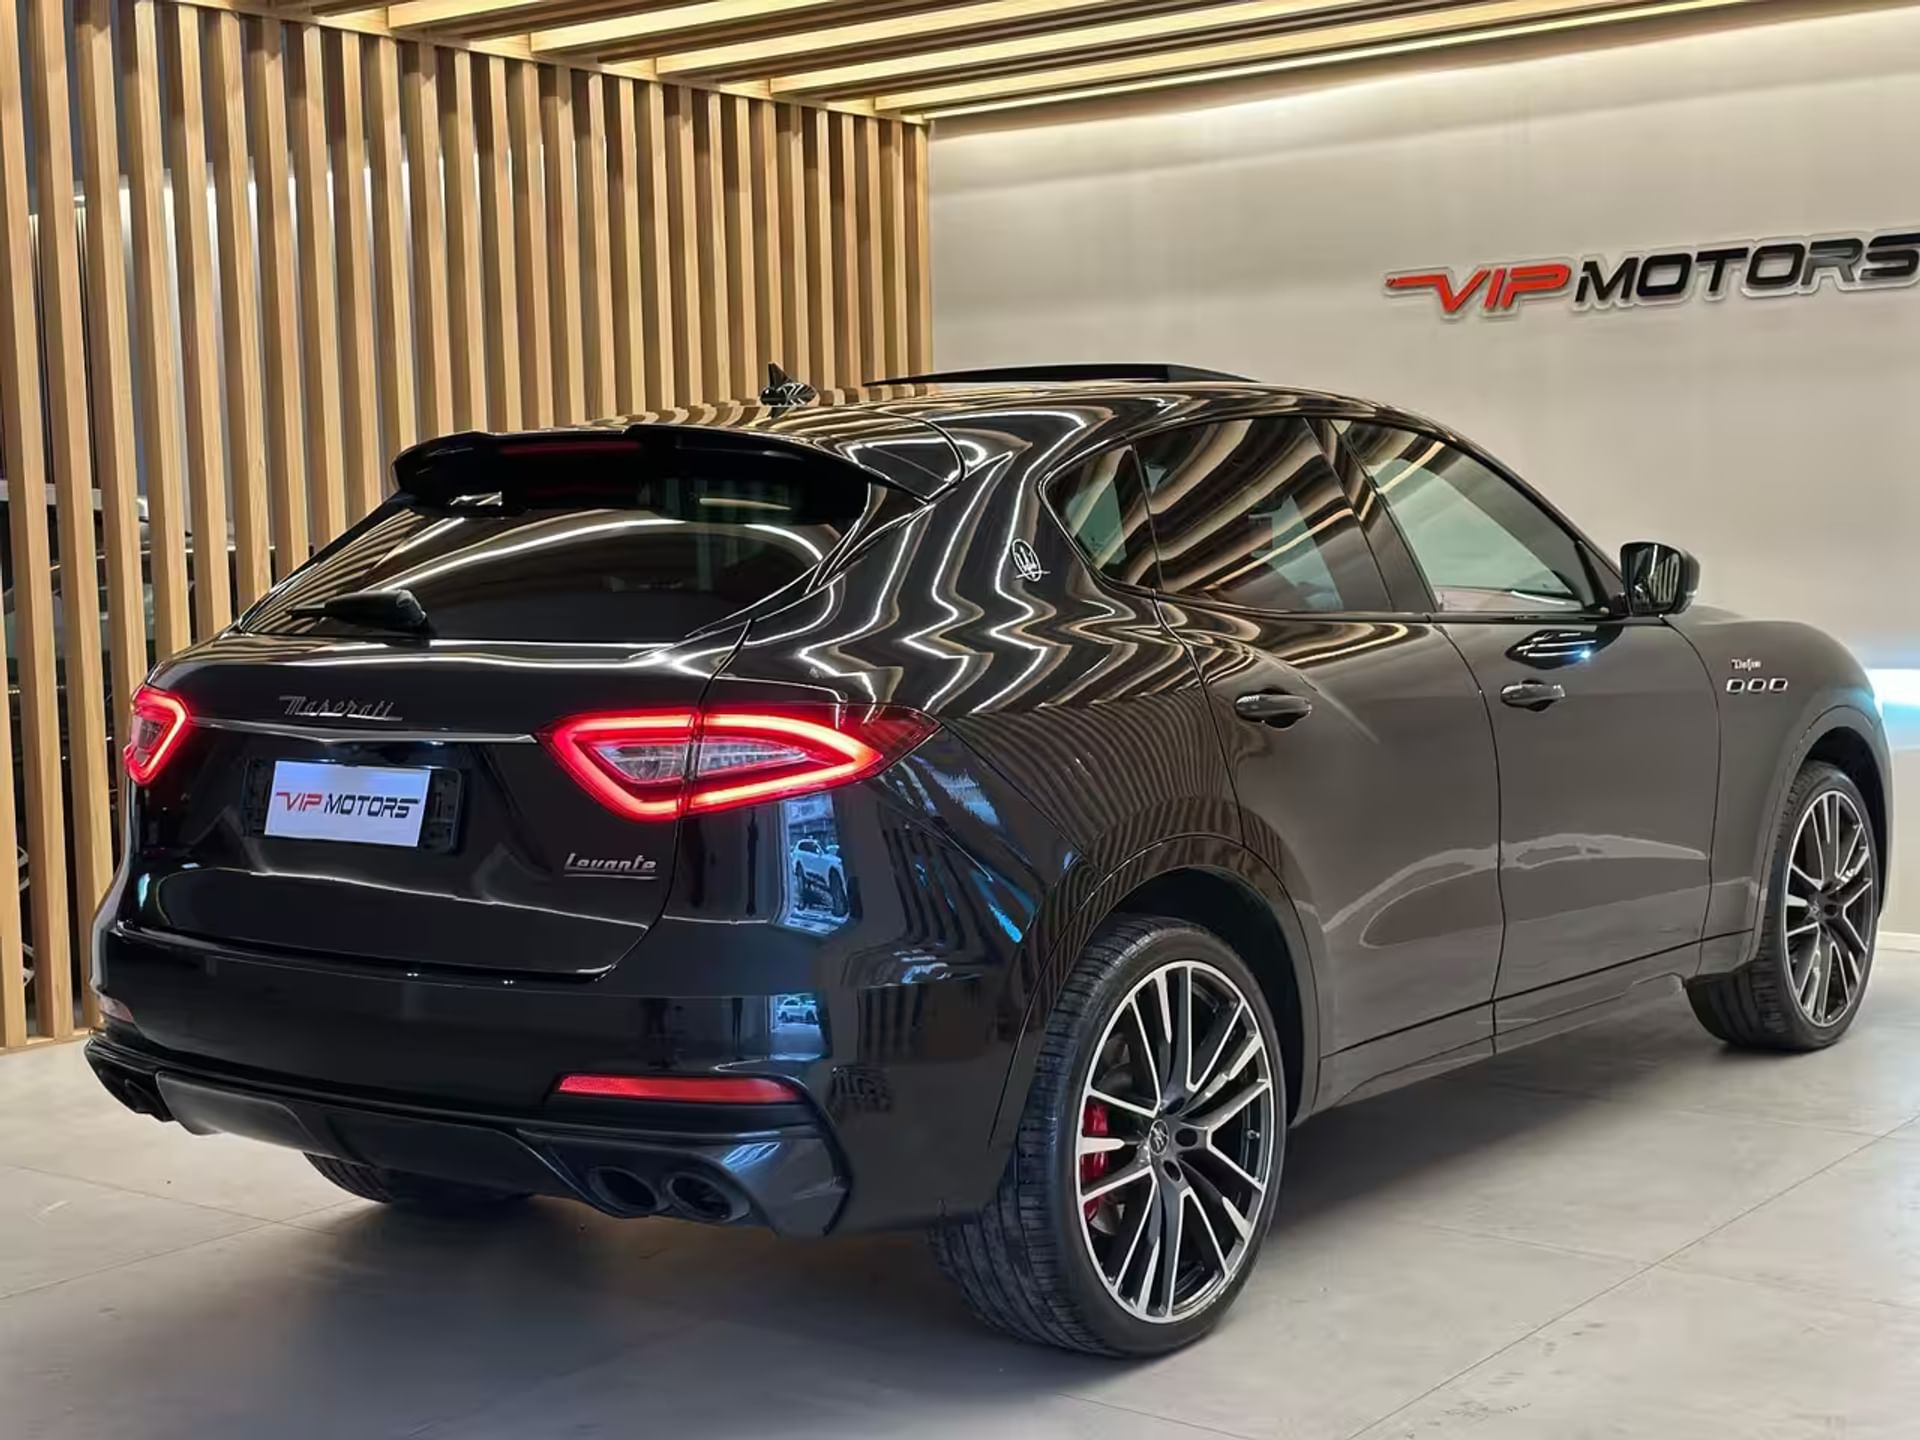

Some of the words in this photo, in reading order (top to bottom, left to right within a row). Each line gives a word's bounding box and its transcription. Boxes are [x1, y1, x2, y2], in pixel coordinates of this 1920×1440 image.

[1386, 263, 1572, 313] VIP
[1574, 232, 1920, 303] MOTORS
[279, 696, 403, 721] Maserati
[276, 791, 323, 812] VIP
[323, 793, 420, 819] MOTORS
[564, 852, 657, 873] Levante
